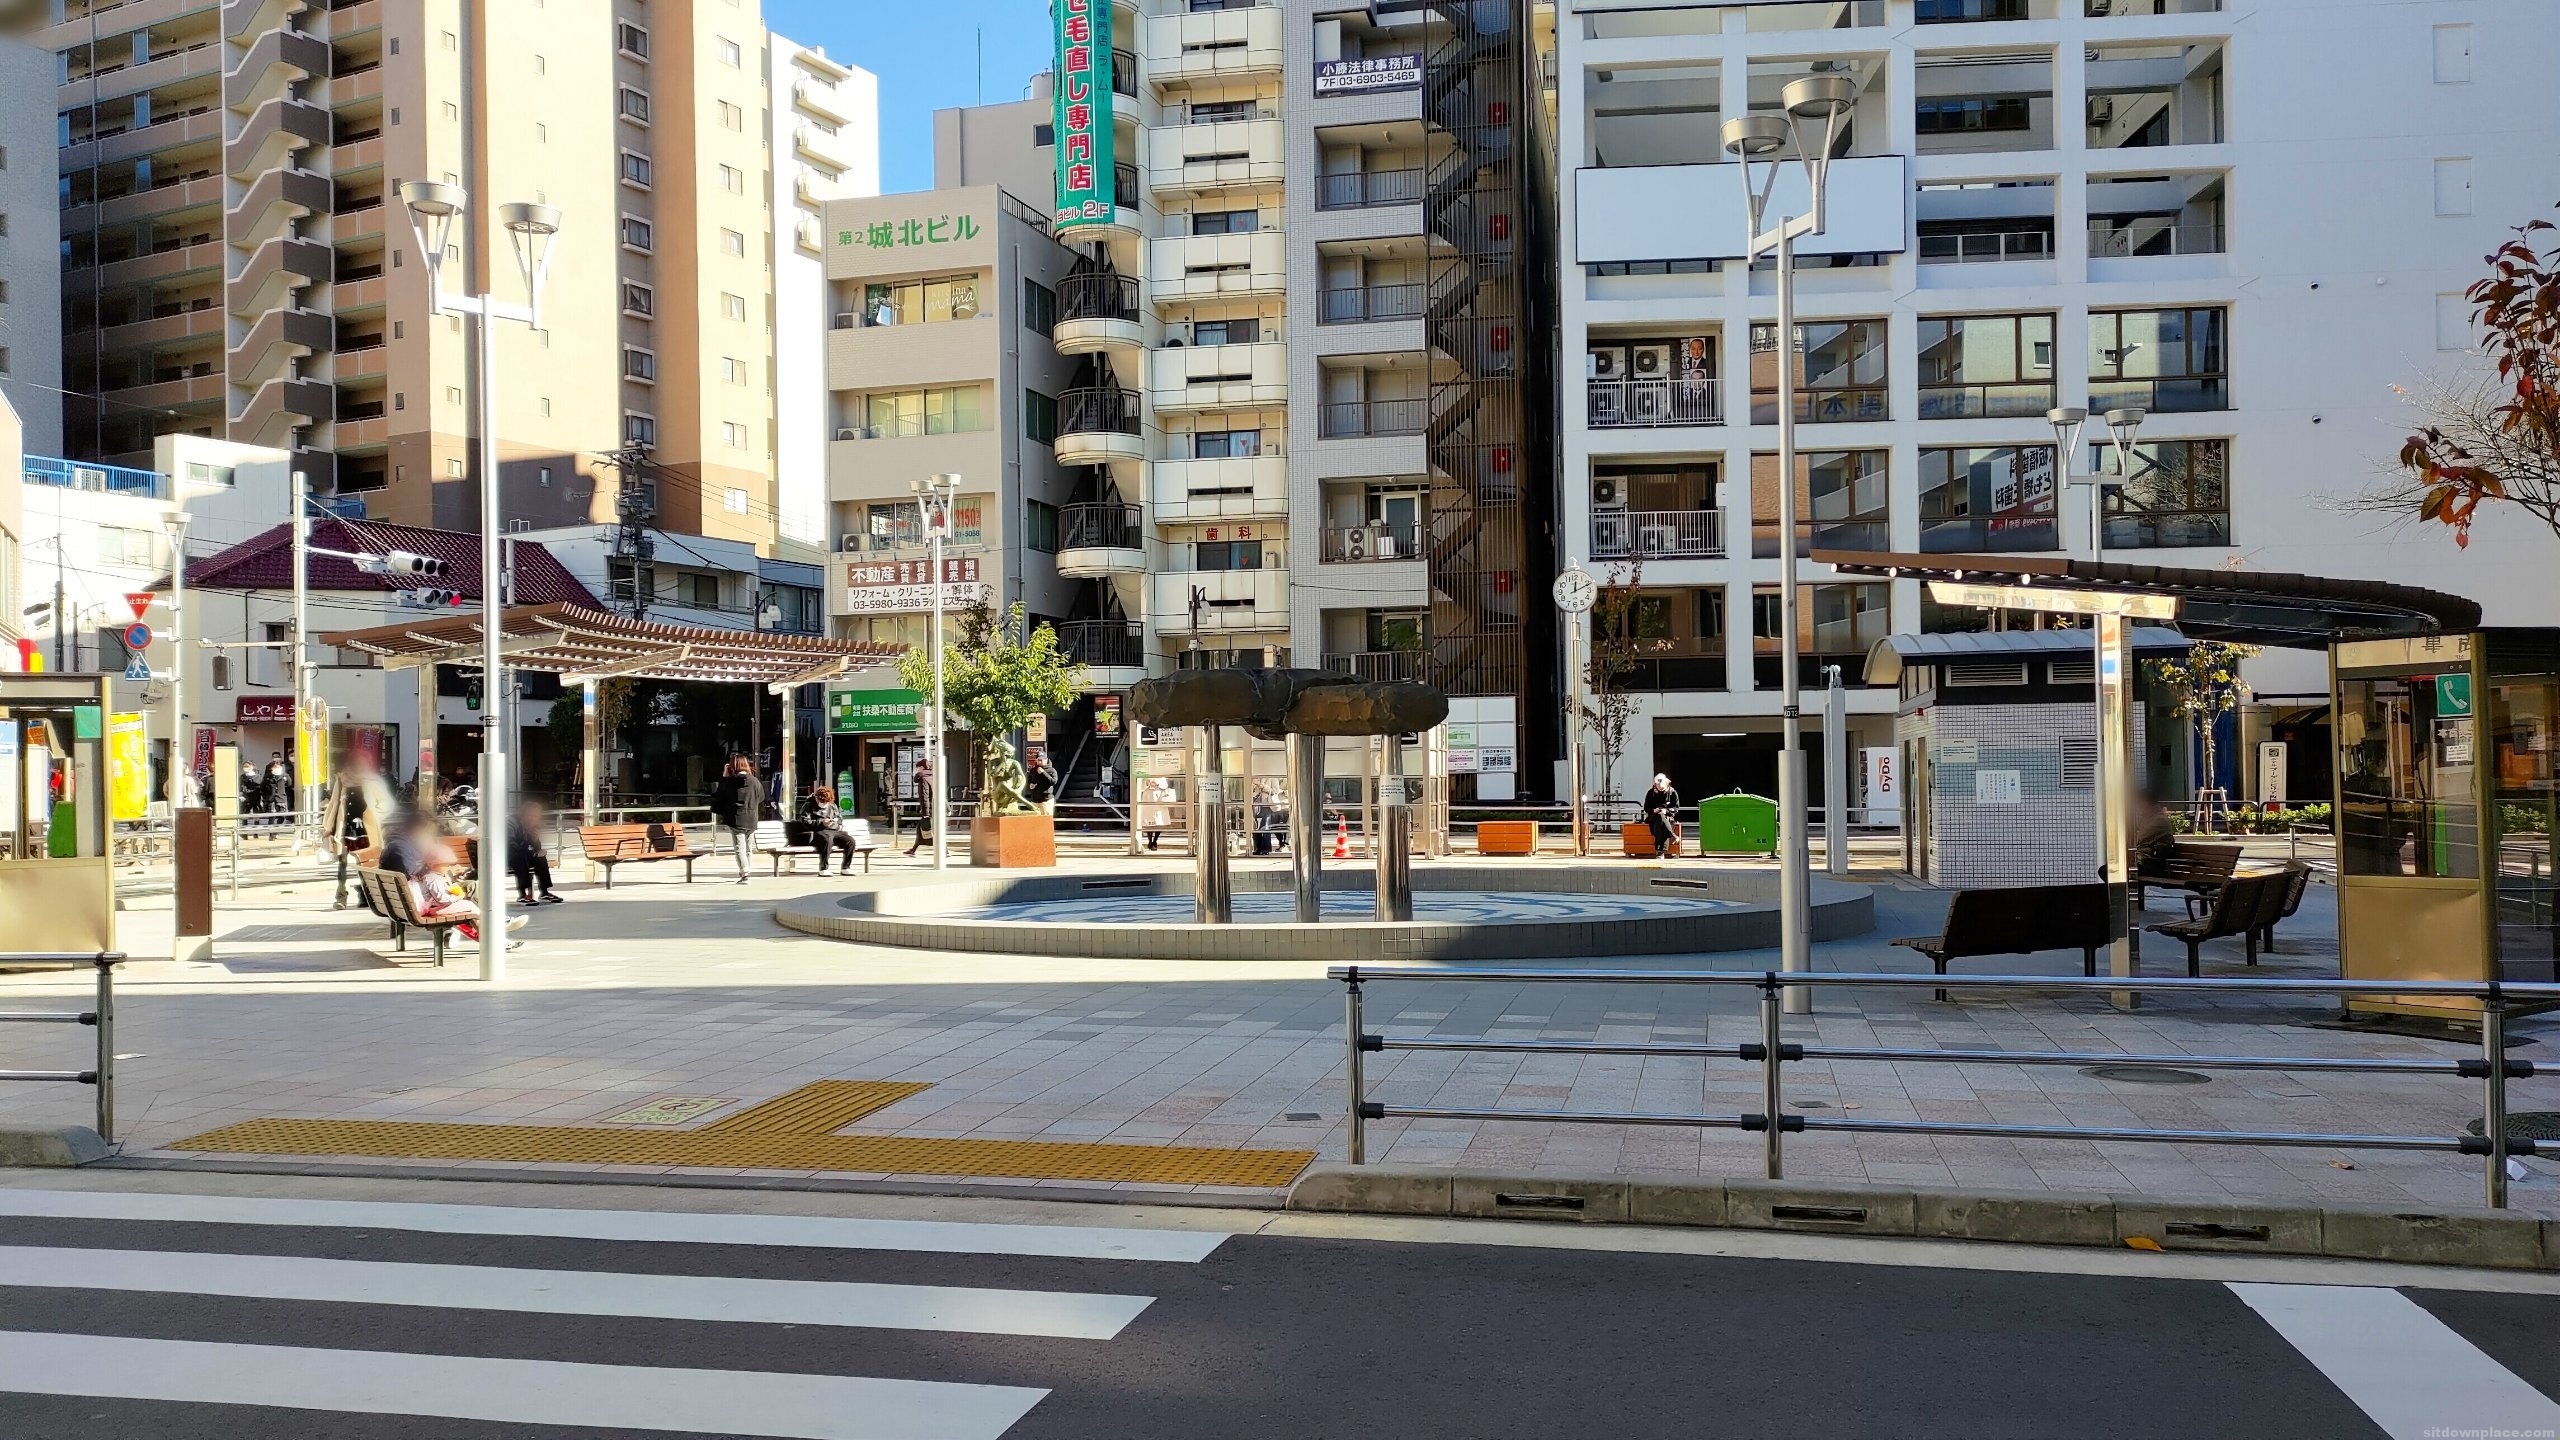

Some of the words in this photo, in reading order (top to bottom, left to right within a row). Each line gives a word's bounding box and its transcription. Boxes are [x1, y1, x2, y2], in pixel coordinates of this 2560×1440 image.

[1322, 55, 1415, 77] 小藤法律事務所
[1321, 78, 1336, 88] 7F
[1339, 71, 1415, 87] 03-6903-5469
[1083, 200, 1110, 218] 2F
[1206, 525, 1252, 541] 歯科
[852, 566, 896, 584] 不動産
[964, 559, 976, 581] 相続
[853, 599, 920, 610] 03-5980-9336
[1881, 756, 1893, 792] DyDo
